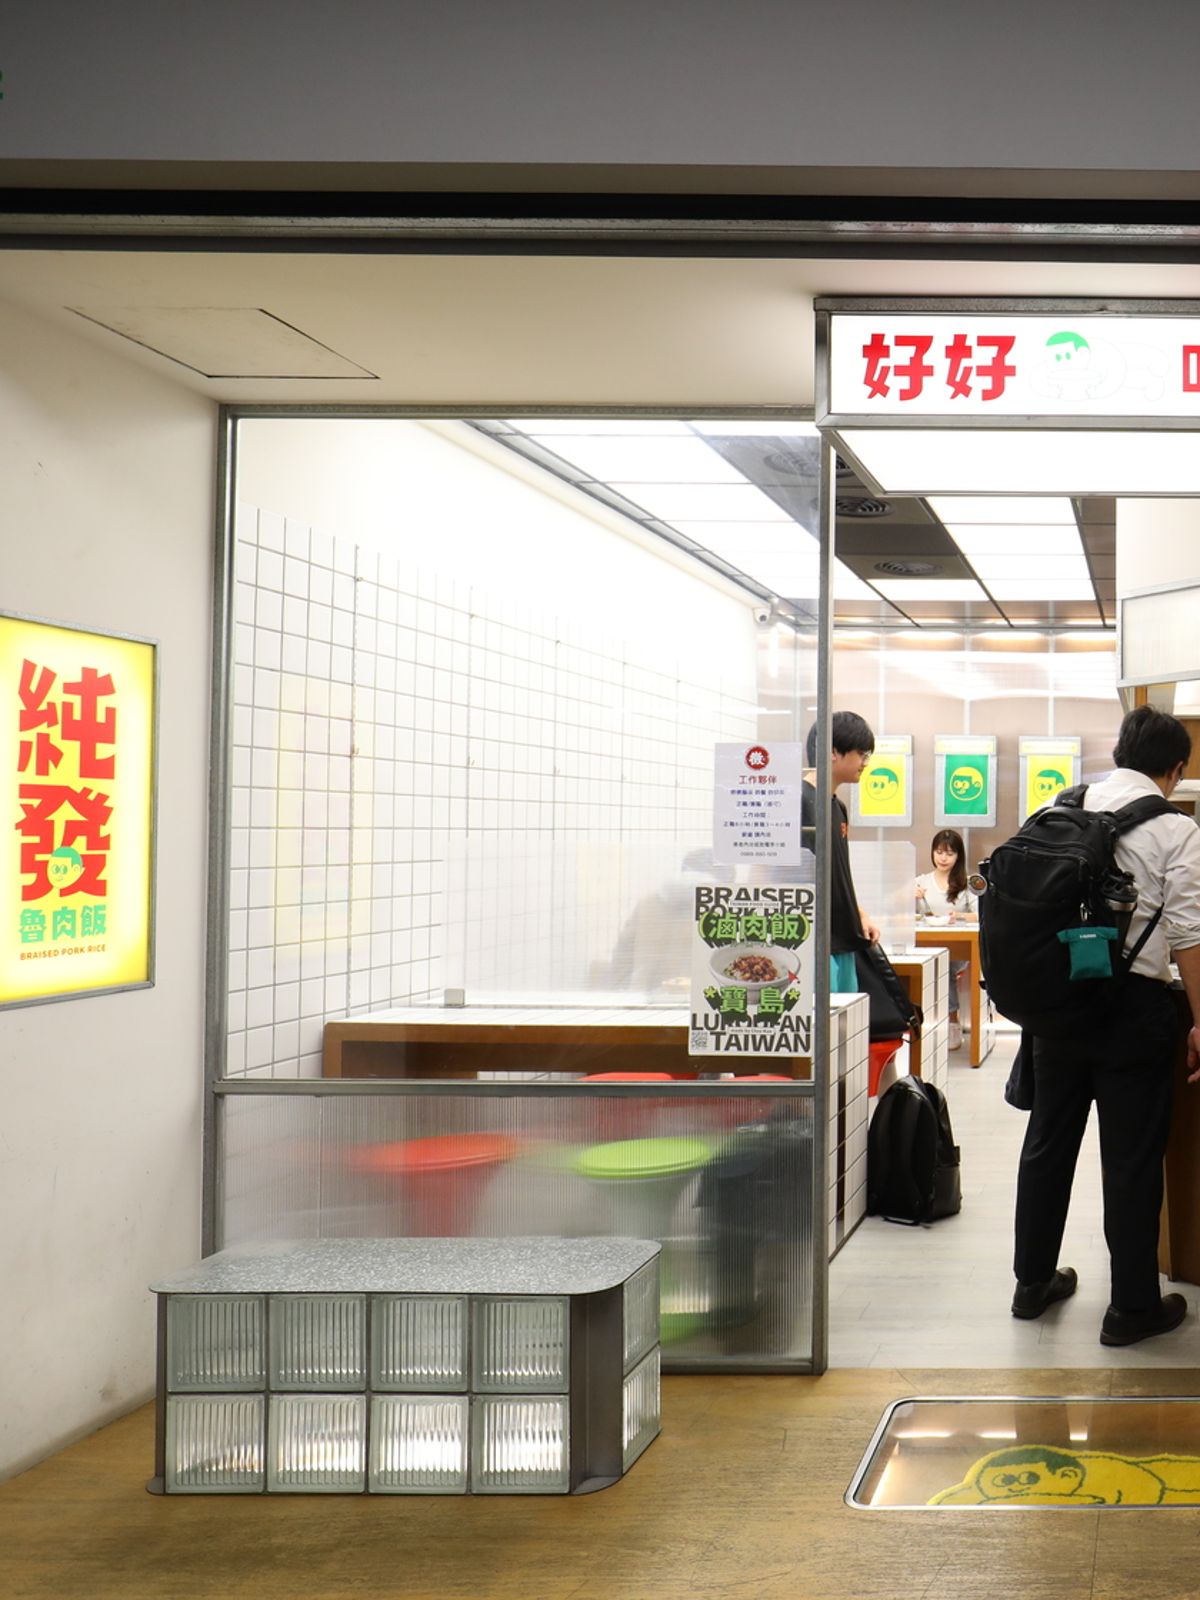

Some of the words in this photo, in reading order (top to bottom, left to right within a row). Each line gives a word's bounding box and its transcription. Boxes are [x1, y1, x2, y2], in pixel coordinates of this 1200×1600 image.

[862, 333, 1016, 401] 好好
[15, 658, 116, 902] 純發
[695, 886, 814, 908] BRAISED
[19, 904, 107, 943] 魯肉飯
[20, 949, 60, 961] BRAISED
[61, 946, 85, 956] PORK
[87, 944, 106, 953] RICE
[710, 1031, 811, 1053] TAIWAN
